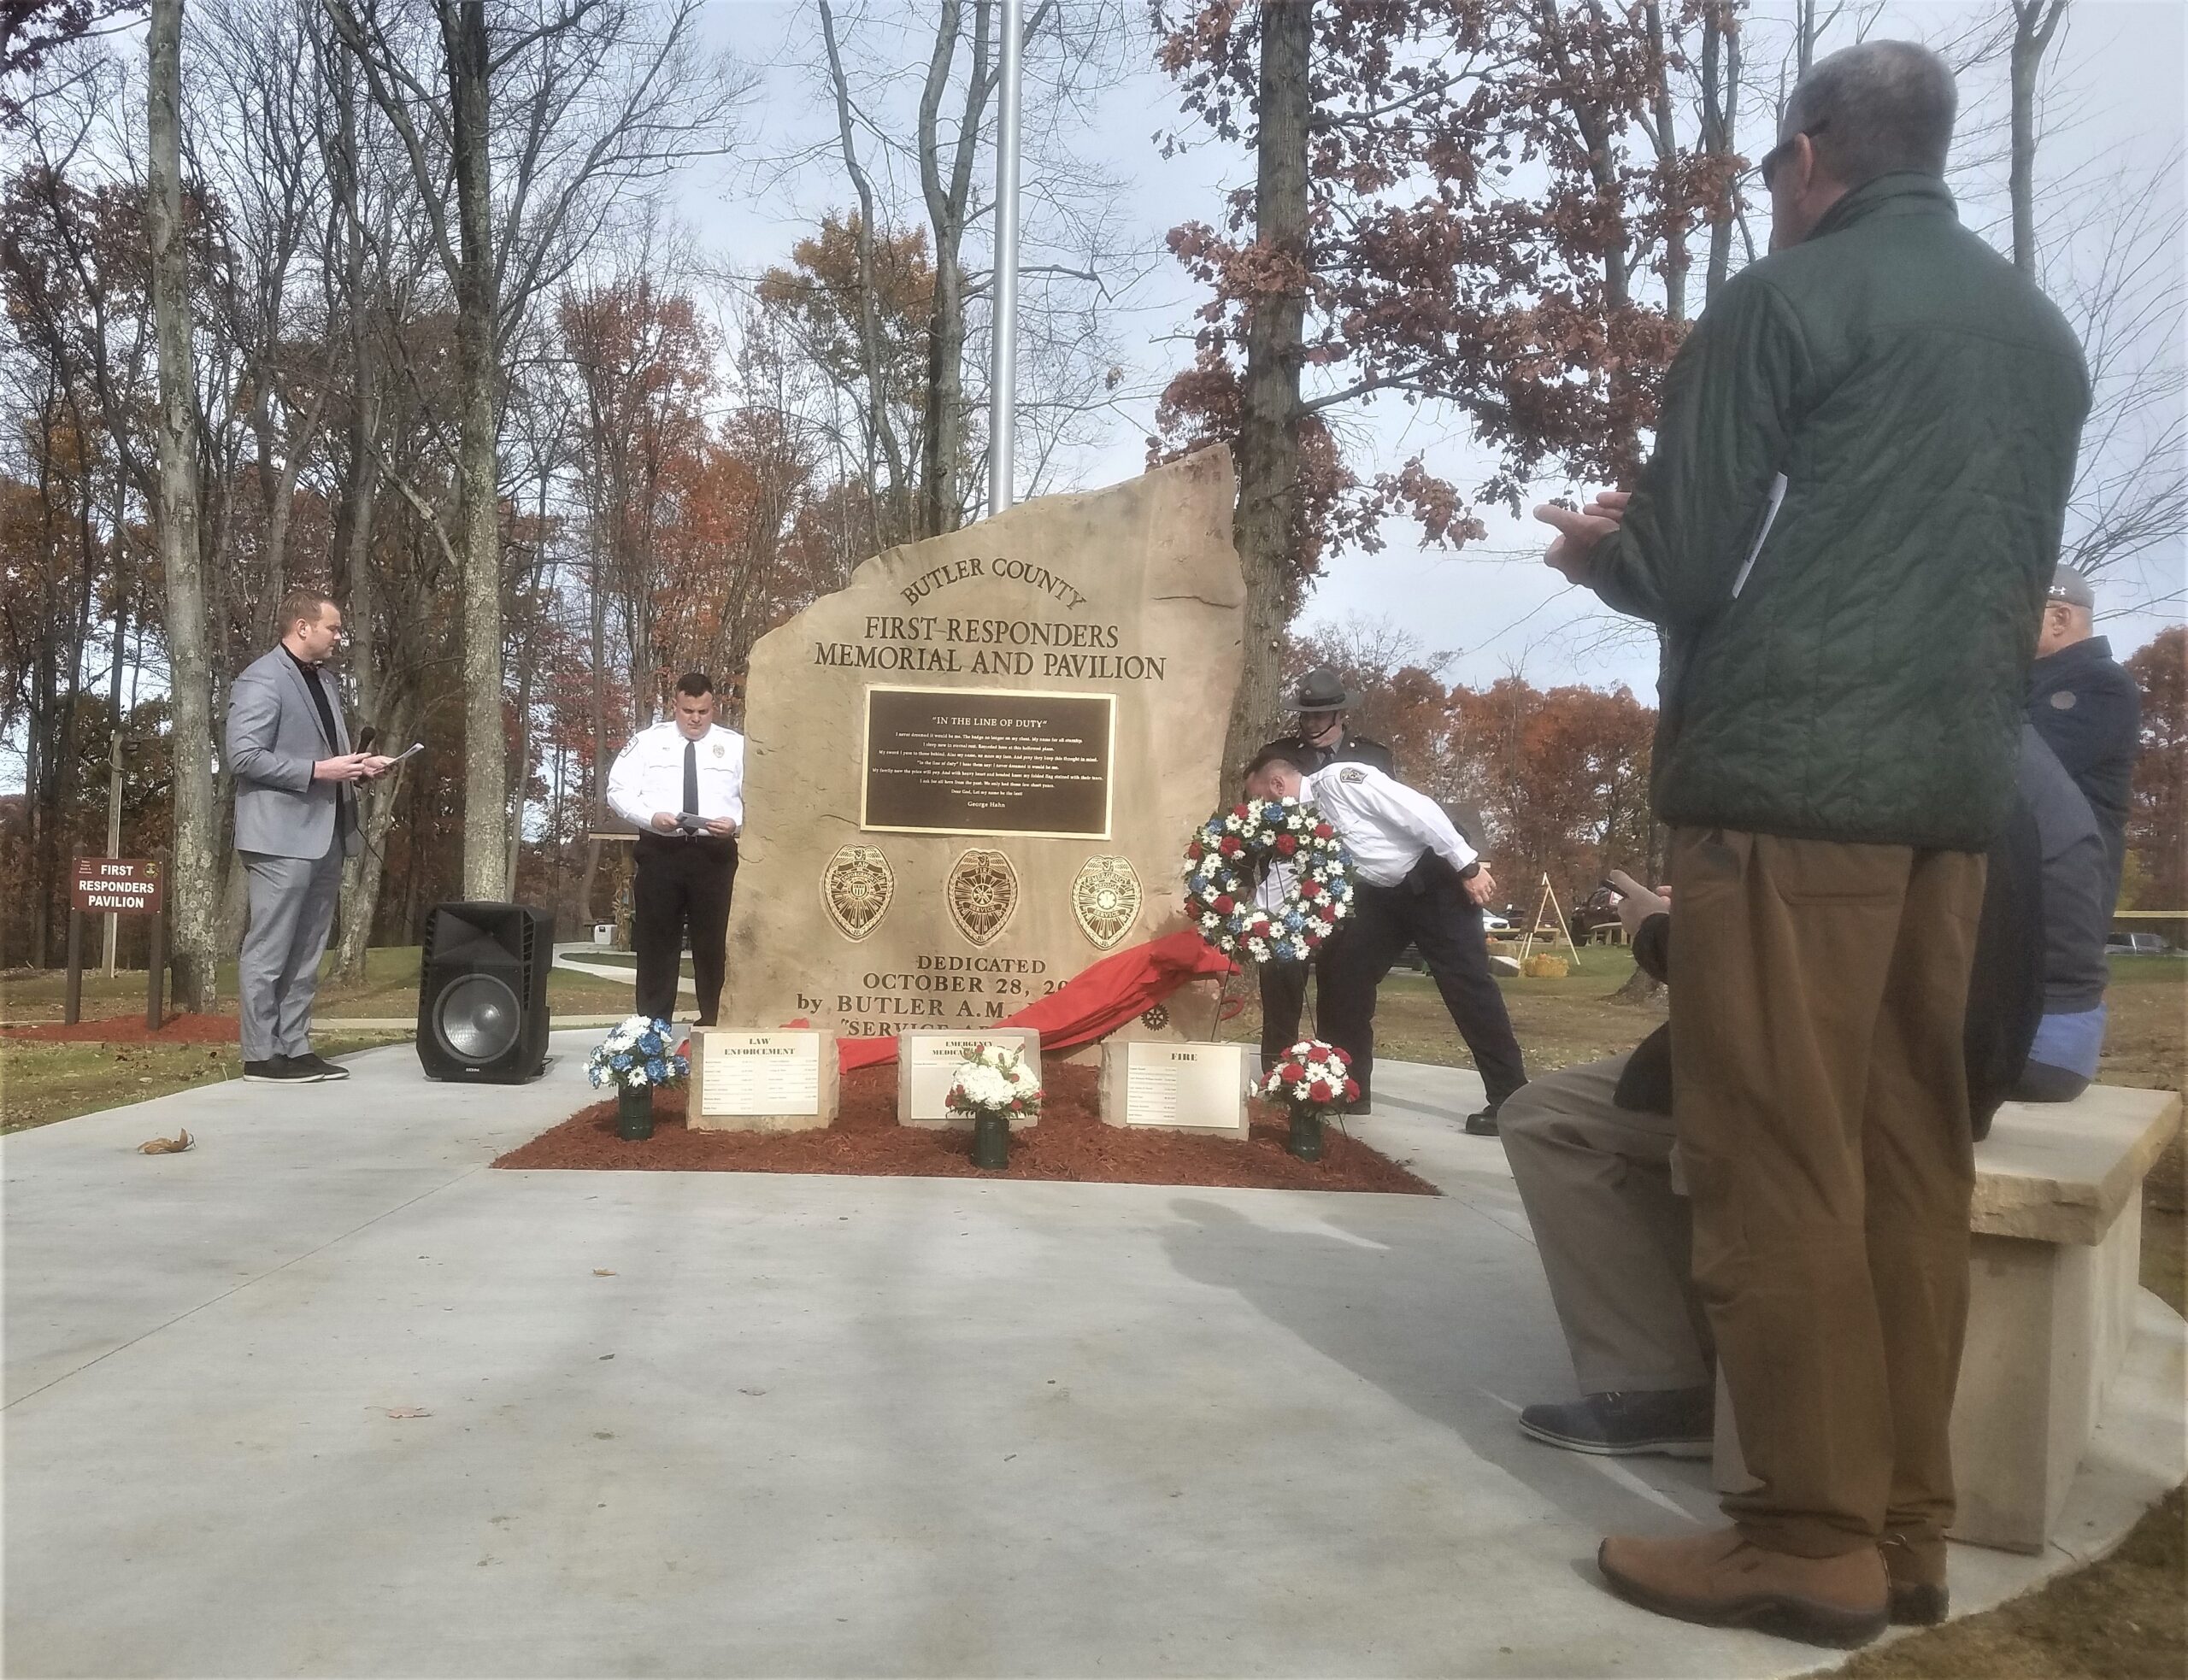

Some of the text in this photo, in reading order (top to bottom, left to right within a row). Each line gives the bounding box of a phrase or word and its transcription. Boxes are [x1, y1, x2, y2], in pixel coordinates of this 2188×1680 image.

[900, 558, 1087, 610] BUTLER COUNTY
[864, 616, 1119, 649] FIRST RESPONDERS
[814, 643, 1167, 682] MEMORIAL AND PAVILION
[932, 716, 1047, 728] "IN THE LINE OF DUTY"
[101, 864, 134, 877] FIRST
[1087, 872, 1130, 885] EMERGENCY
[79, 880, 155, 894] RESPONDERS
[88, 895, 144, 908] PAVILION
[969, 904, 996, 913] SERVICE
[1093, 909, 1120, 919] SERVICE
[917, 955, 1046, 974] DEDICATED
[862, 972, 1068, 997] OCTOBER 28, 20
[797, 993, 823, 1014] by
[837, 995, 945, 1016] BUTLER
[1171, 1052, 1197, 1061] FIRE
